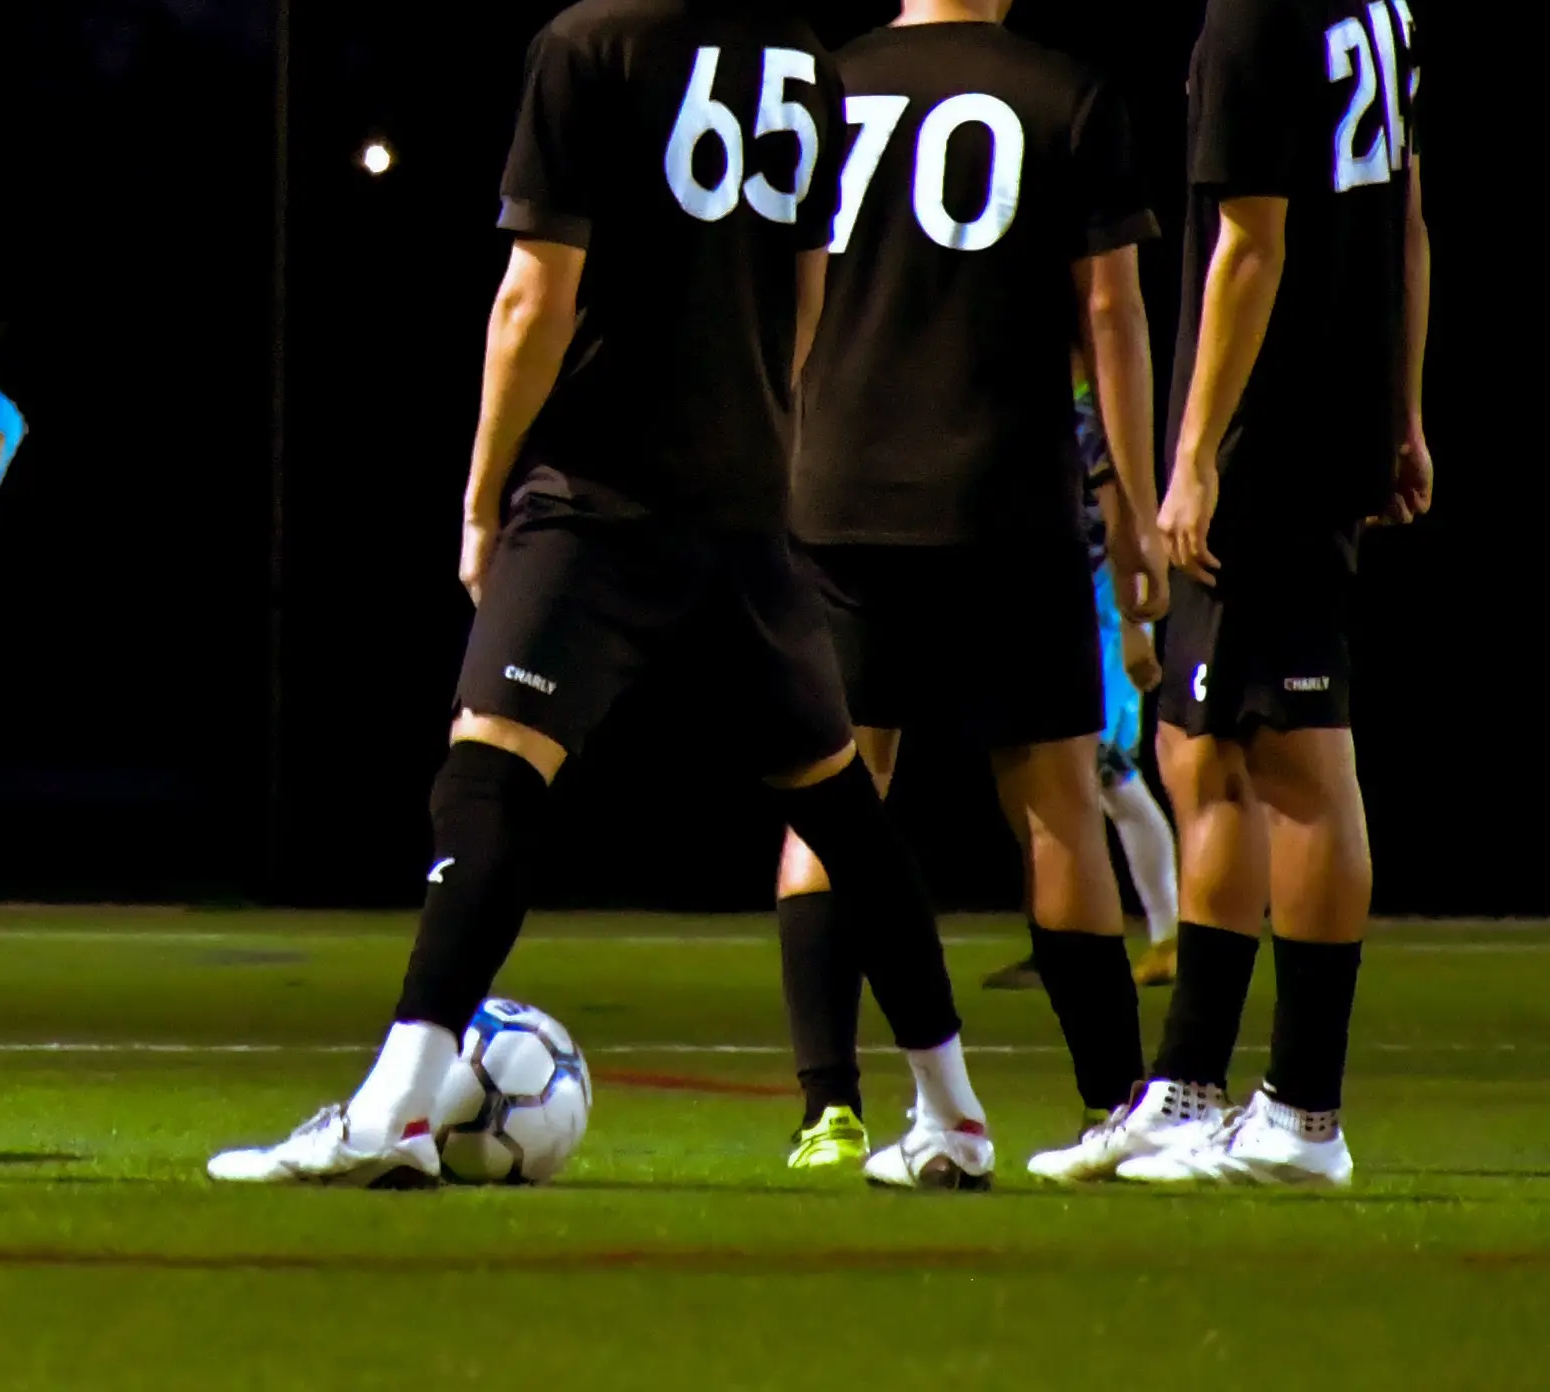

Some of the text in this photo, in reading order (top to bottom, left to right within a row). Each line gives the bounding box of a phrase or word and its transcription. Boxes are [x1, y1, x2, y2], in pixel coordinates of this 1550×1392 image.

[665, 46, 818, 223] 65
[827, 93, 1025, 253] 70
[504, 665, 557, 695] CHARLY
